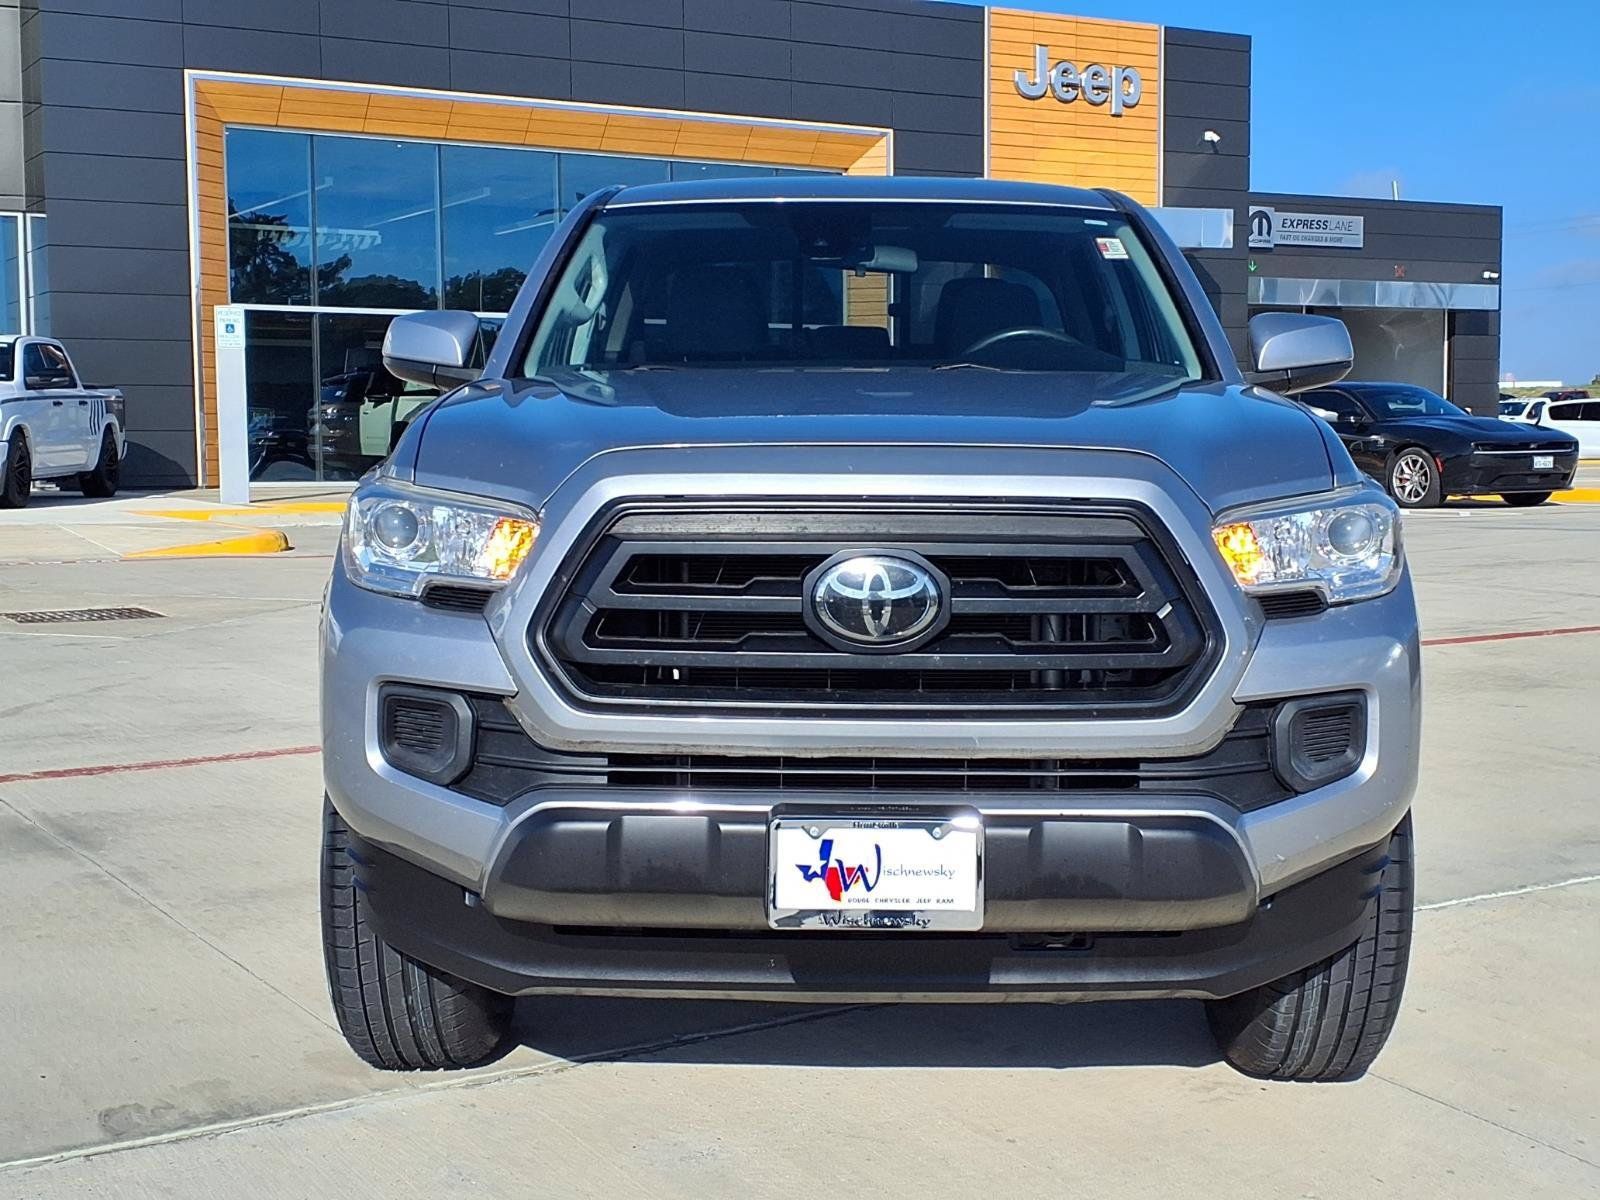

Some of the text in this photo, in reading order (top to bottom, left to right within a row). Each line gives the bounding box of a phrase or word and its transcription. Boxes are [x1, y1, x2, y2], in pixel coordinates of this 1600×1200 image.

[1014, 44, 1141, 117] Jeep
[835, 843, 956, 893] Wischnewsky
[821, 909, 931, 929] Wischnewsky
